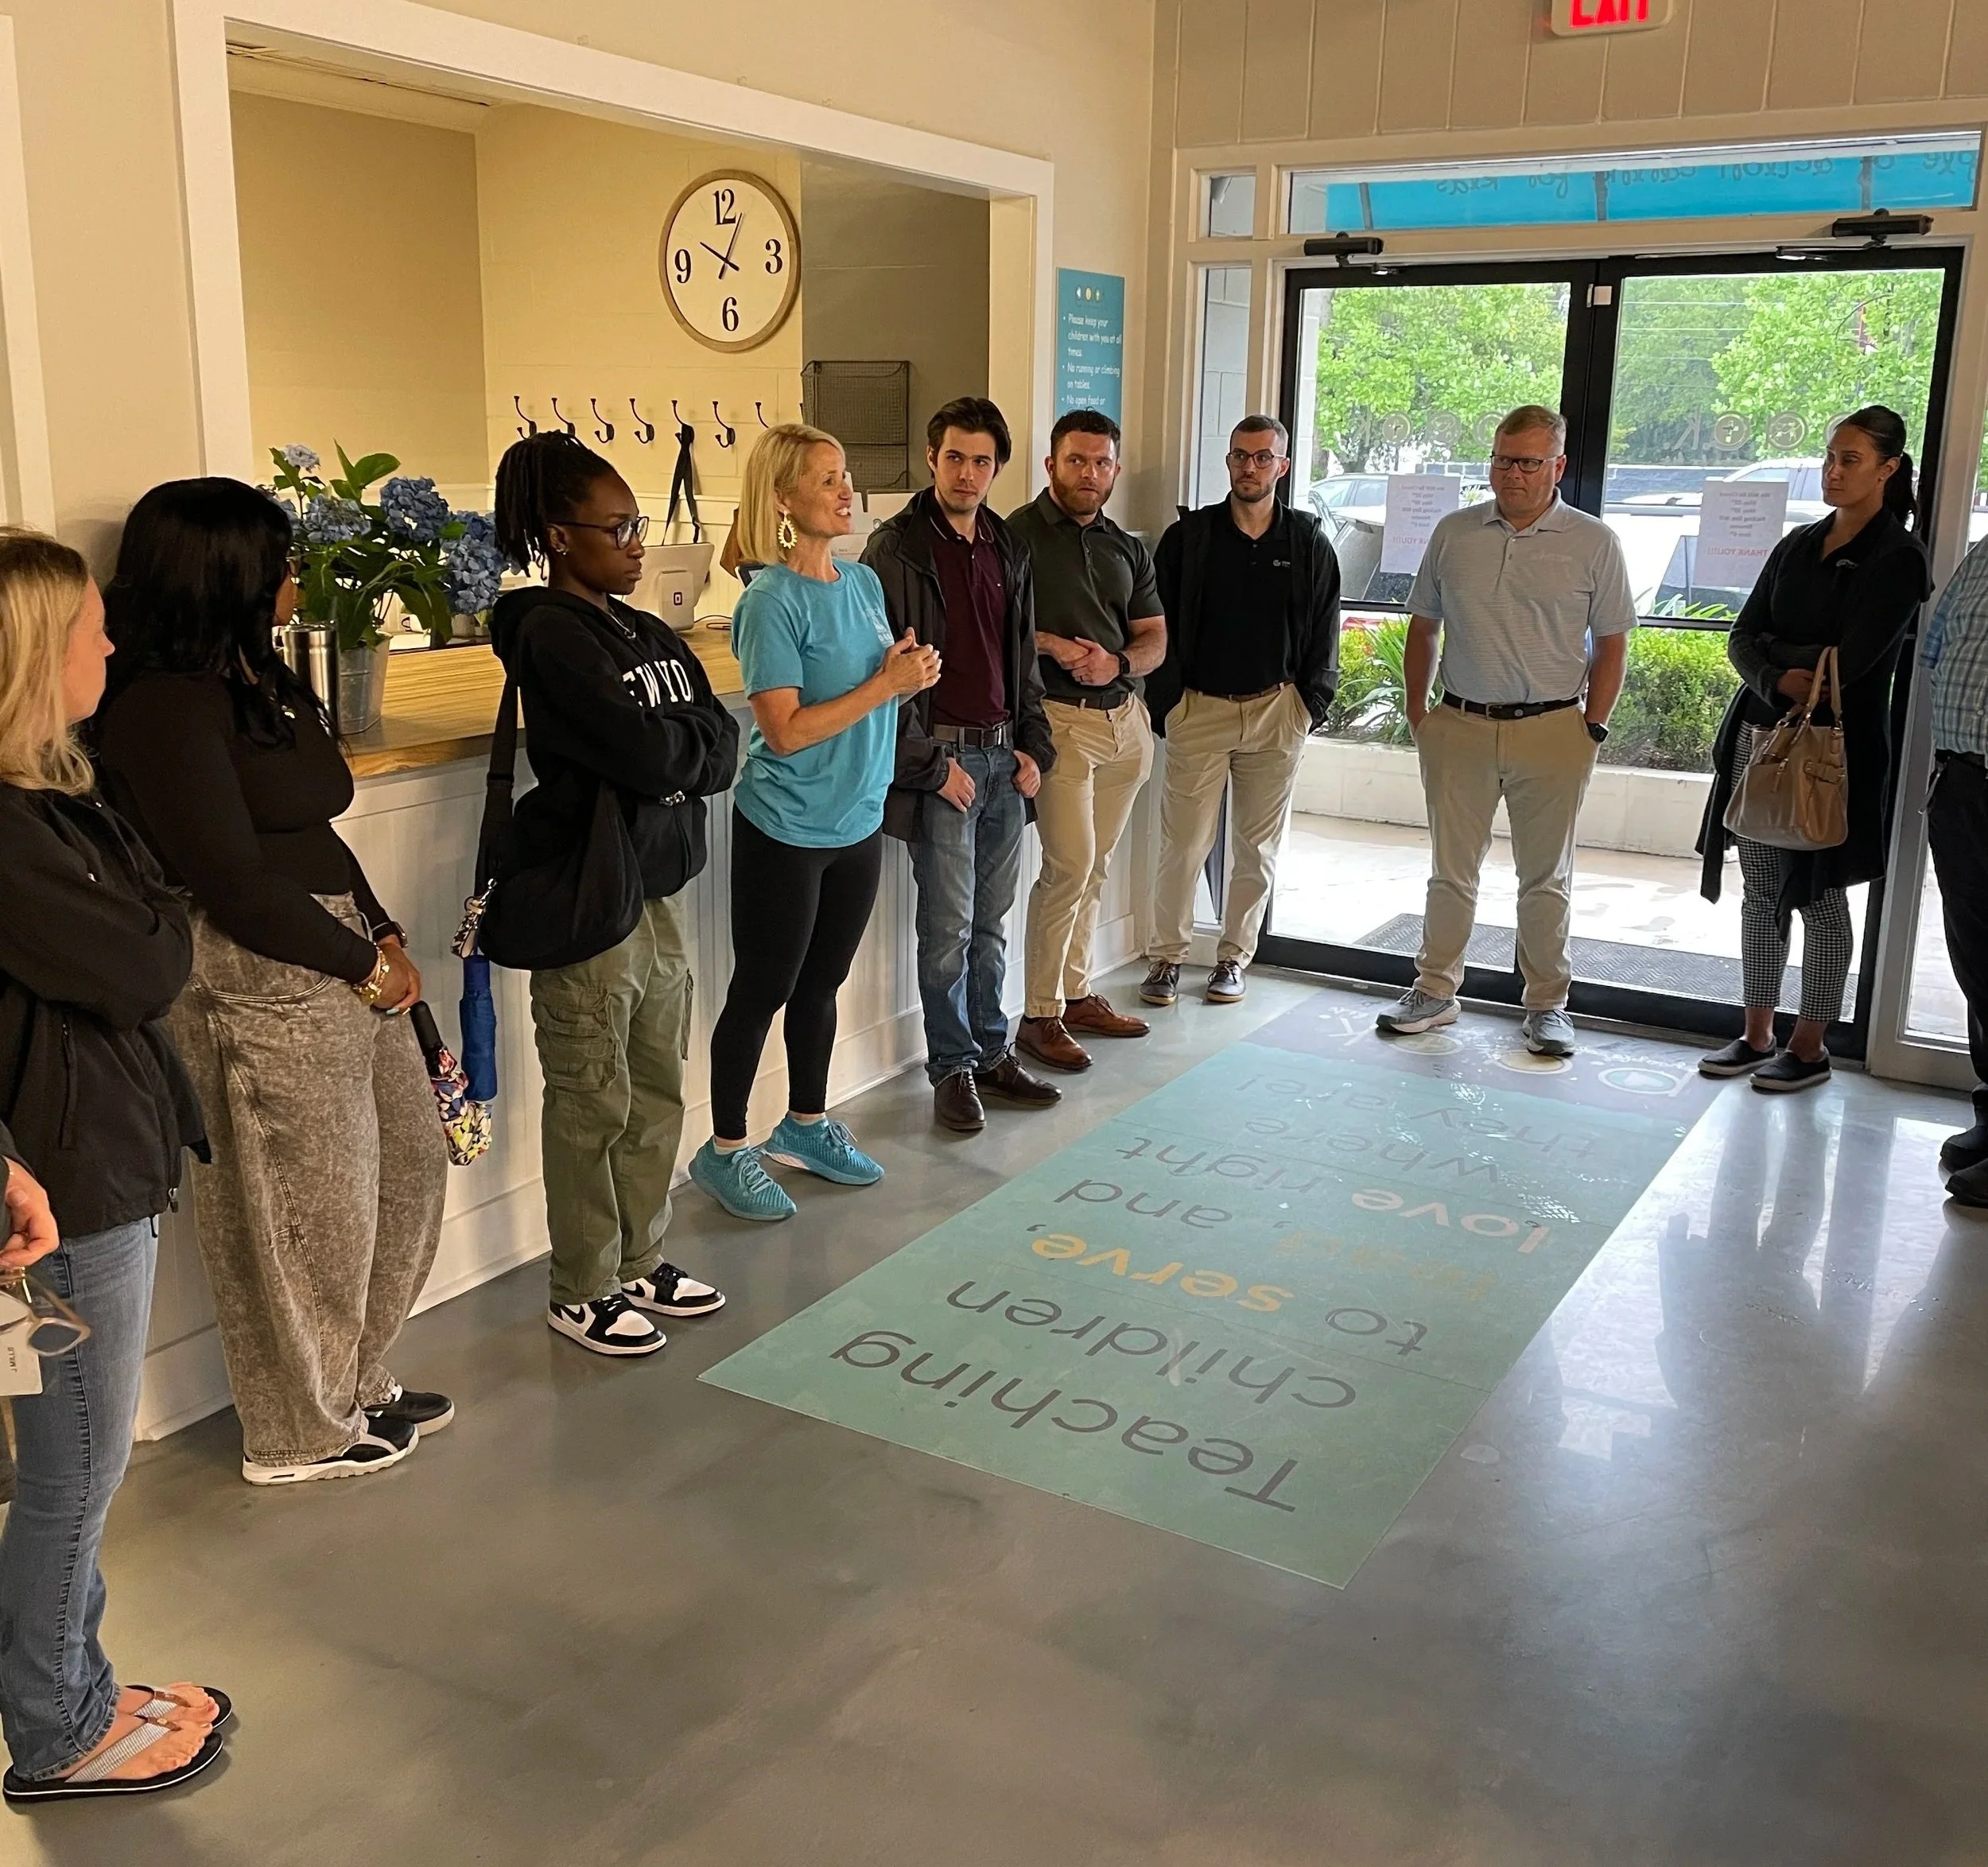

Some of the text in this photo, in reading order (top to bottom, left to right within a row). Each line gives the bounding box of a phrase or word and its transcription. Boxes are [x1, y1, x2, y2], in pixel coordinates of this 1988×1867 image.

[712, 188, 736, 225] 12
[674, 249, 692, 284] 9
[765, 239, 783, 274] 3
[722, 297, 739, 332] 6
[1068, 312, 1109, 328] Please keep your
[1068, 329, 1089, 342] children
[1089, 332, 1100, 342] with
[1101, 336, 1109, 345] you
[1067, 363, 1075, 372] No
[1076, 365, 1093, 376] running
[1101, 364, 1120, 378] climbing
[1066, 394, 1074, 405] No
[1075, 397, 1086, 407] open
[1087, 394, 1099, 405] food
[1236, 1073, 1595, 1159] they are!
[1245, 1117, 1501, 1185] where
[1053, 1178, 1233, 1229] and
[1116, 1136, 1551, 1254] love right
[1026, 1223, 1429, 1357] to serve,
[946, 1279, 1357, 1410] children
[828, 1329, 1299, 1513] Teaching
